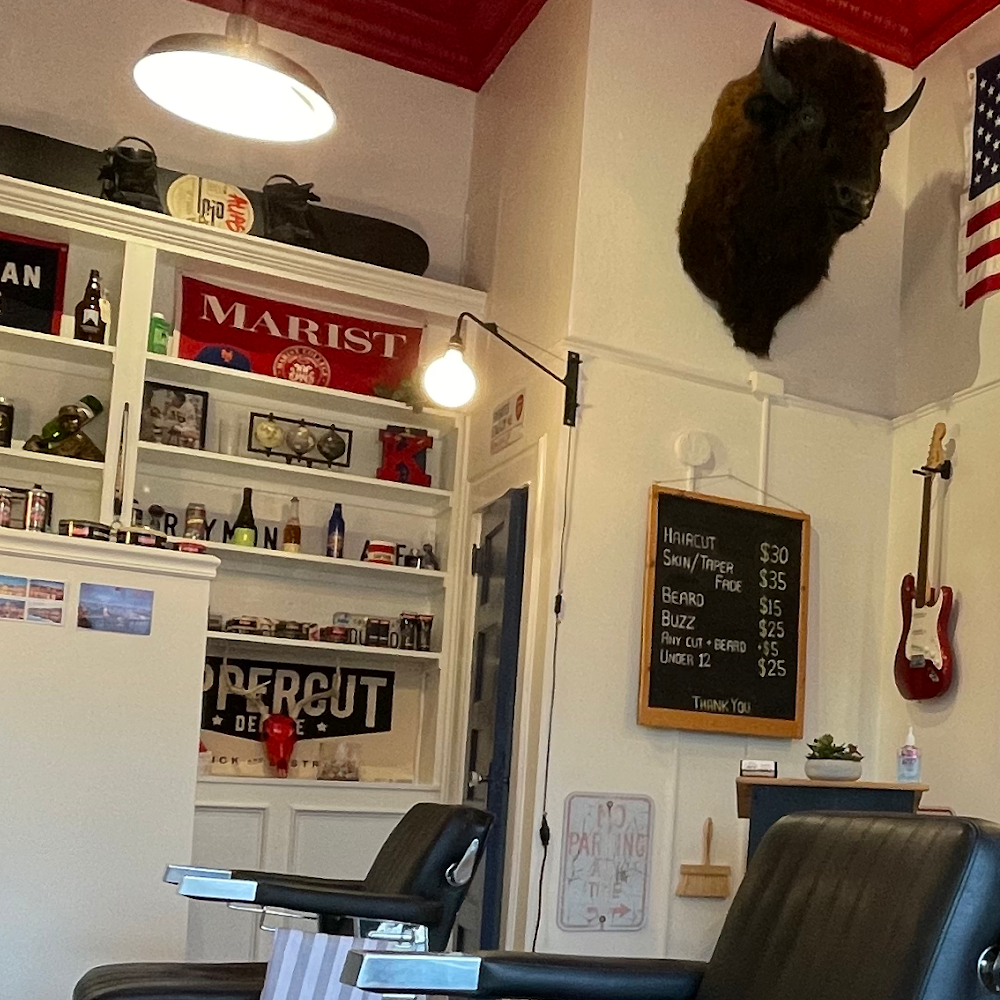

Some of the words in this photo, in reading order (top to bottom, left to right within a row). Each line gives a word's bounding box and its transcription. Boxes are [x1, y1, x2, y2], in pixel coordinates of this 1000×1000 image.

[0, 261, 41, 289] AN
[200, 293, 407, 360] MARIST
[663, 526, 716, 551] HAIRCUT
[760, 542, 789, 565] $30
[715, 574, 743, 593] FADE
[759, 567, 787, 591] $35
[661, 586, 705, 608] BEARD
[759, 595, 782, 617] $15
[661, 609, 696, 631] BUZZ
[758, 618, 785, 639] $25
[685, 636, 703, 649] CUT
[713, 638, 747, 654] BEARD
[698, 652, 711, 668] 12
[758, 658, 787, 678] $25
[691, 695, 730, 713] THANK
[730, 698, 751, 714] YOU
[568, 831, 646, 858] PARING
